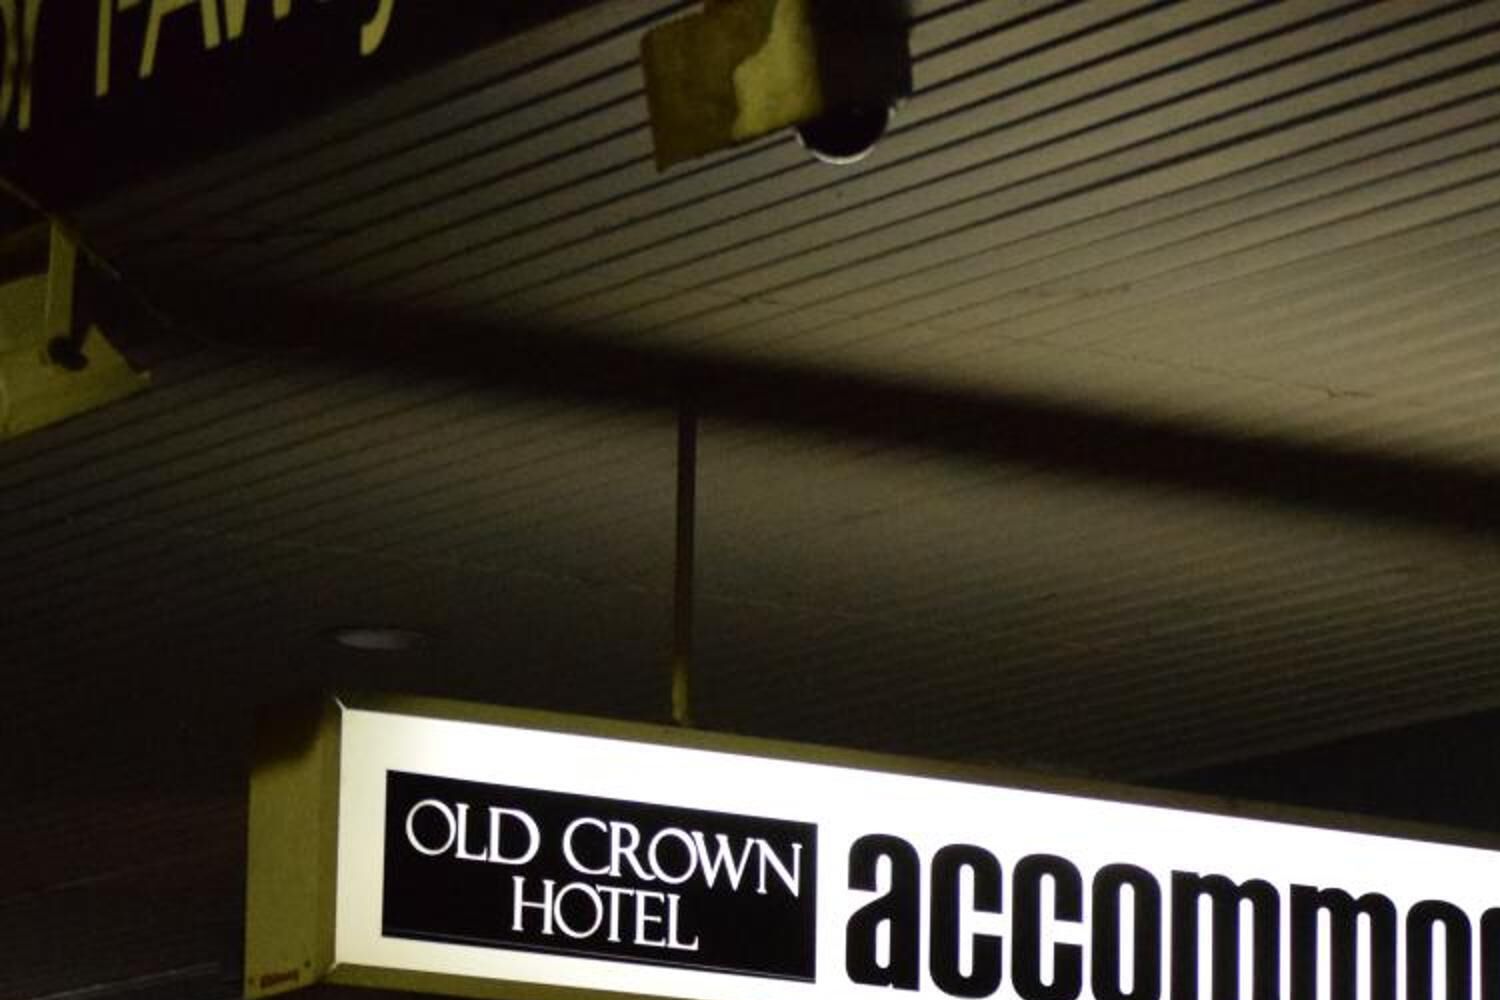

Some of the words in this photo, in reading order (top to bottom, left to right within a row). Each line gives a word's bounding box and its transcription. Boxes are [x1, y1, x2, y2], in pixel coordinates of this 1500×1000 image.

[405, 799, 541, 866] OLD
[562, 816, 803, 898] CROWN
[511, 875, 700, 951] HOTEL
